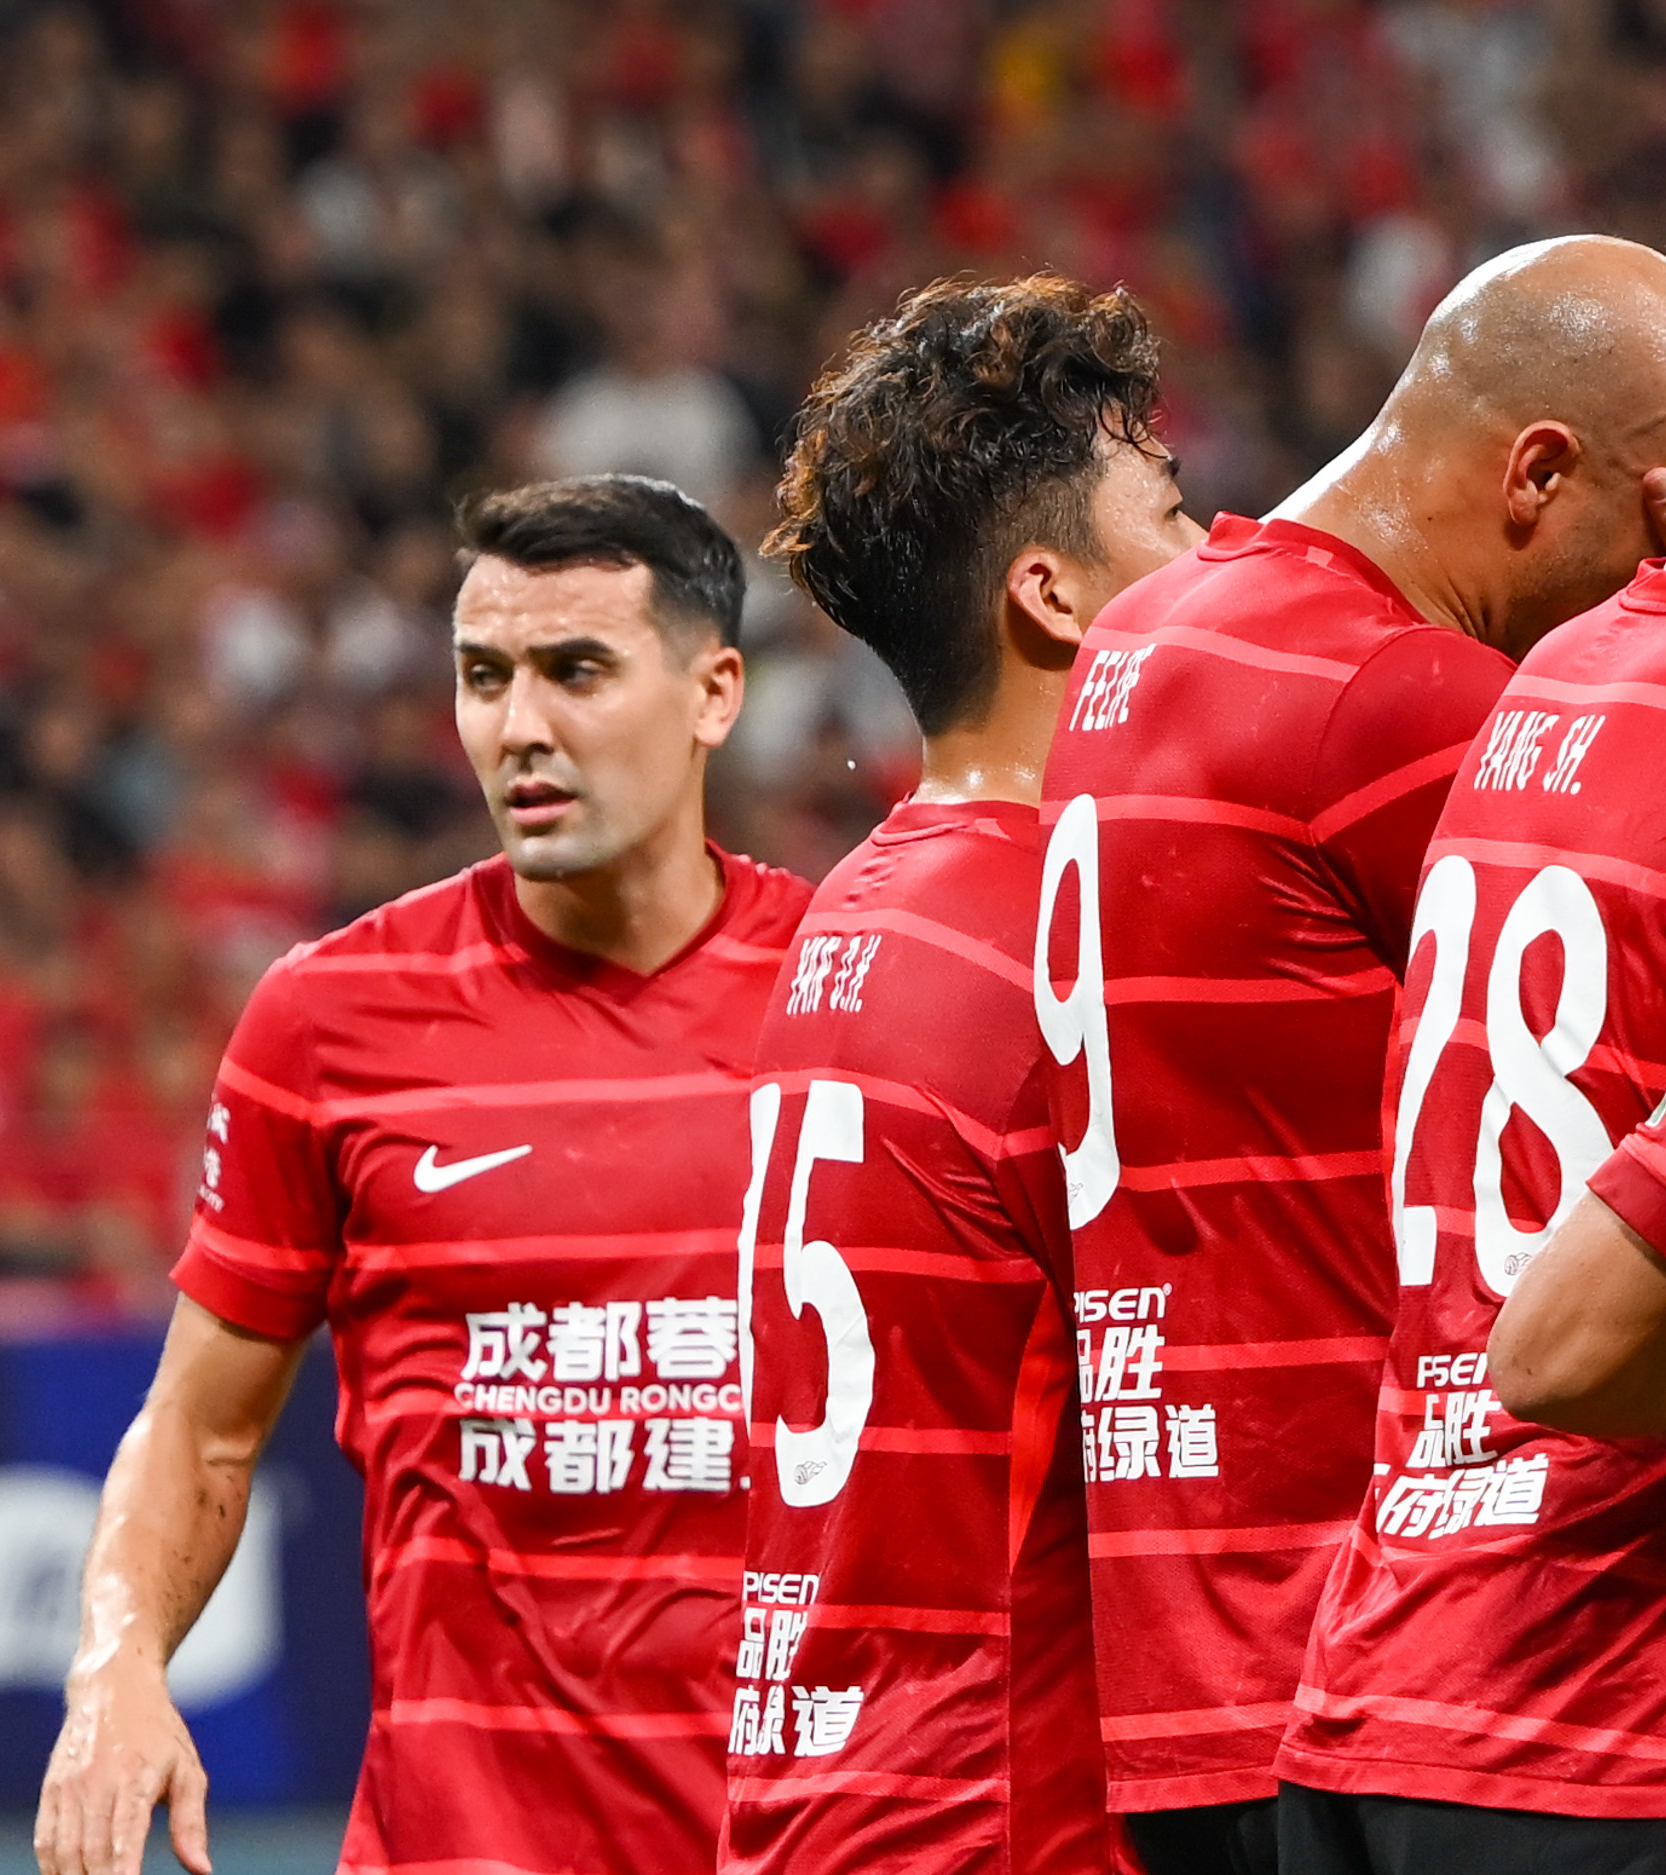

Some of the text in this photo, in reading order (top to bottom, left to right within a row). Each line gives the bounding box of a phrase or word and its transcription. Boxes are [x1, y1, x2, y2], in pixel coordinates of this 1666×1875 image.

[1473, 710, 1606, 796] YANG SH.
[1034, 793, 1121, 1230] 9
[1391, 854, 1616, 1300] 28
[737, 1080, 876, 1508] 15
[459, 1296, 738, 1383] 成都蓉
[453, 1381, 744, 1415] CHENGDU RONGC
[458, 1416, 751, 1495] 成都建
[743, 1570, 822, 1606] PISEN
